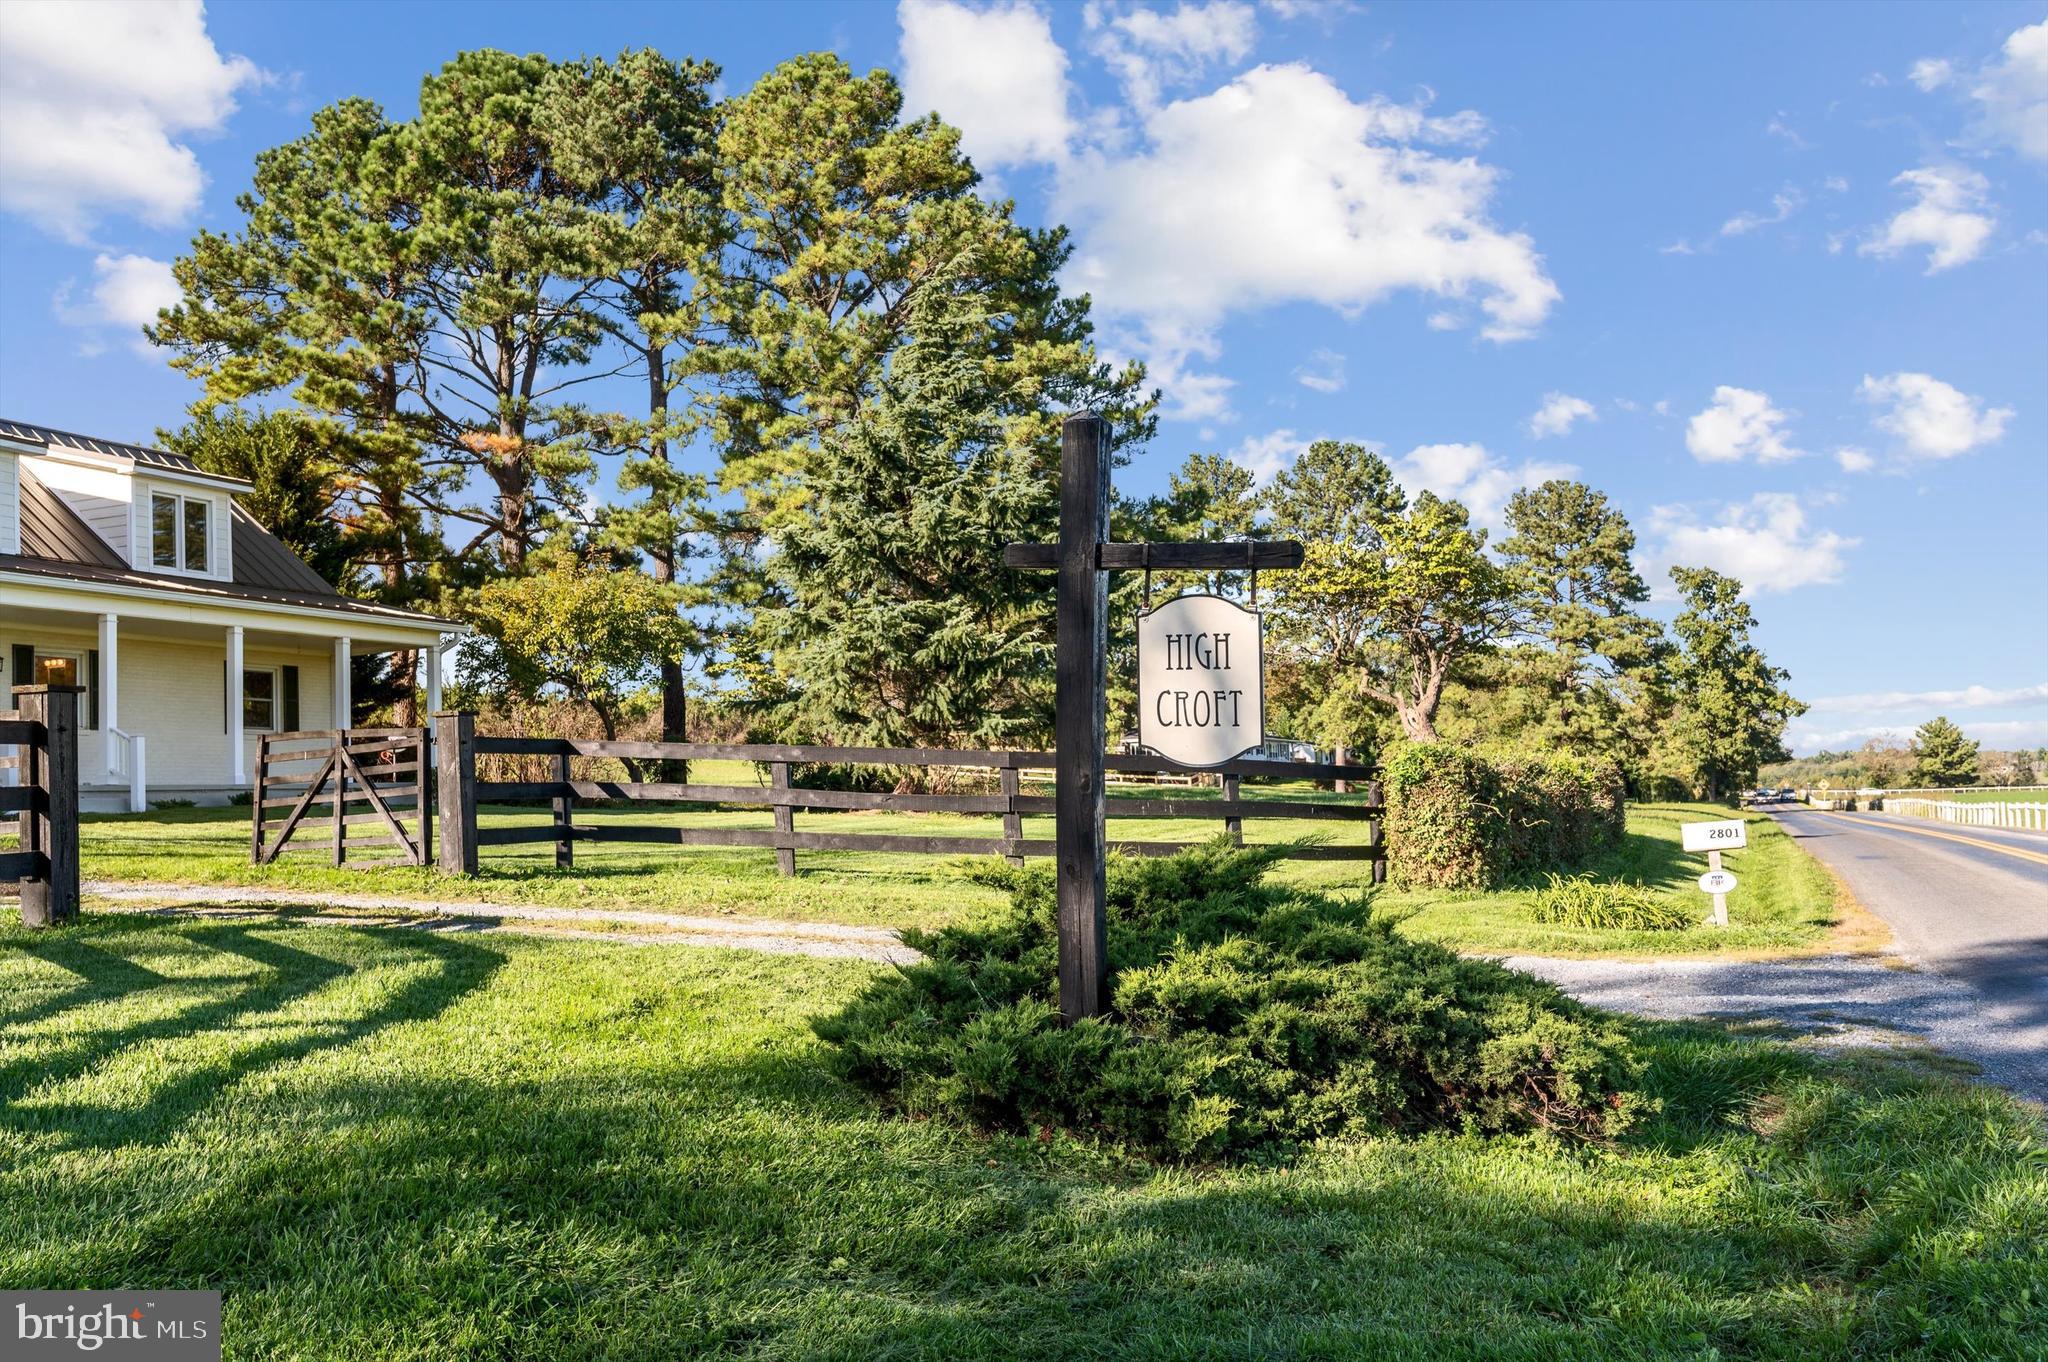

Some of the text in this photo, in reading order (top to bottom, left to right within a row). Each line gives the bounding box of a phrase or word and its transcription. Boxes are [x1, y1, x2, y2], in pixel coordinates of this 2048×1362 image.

[1166, 632, 1231, 670] HIGH
[1156, 690, 1242, 727] CROFT
[1709, 828, 1739, 838] 2801
